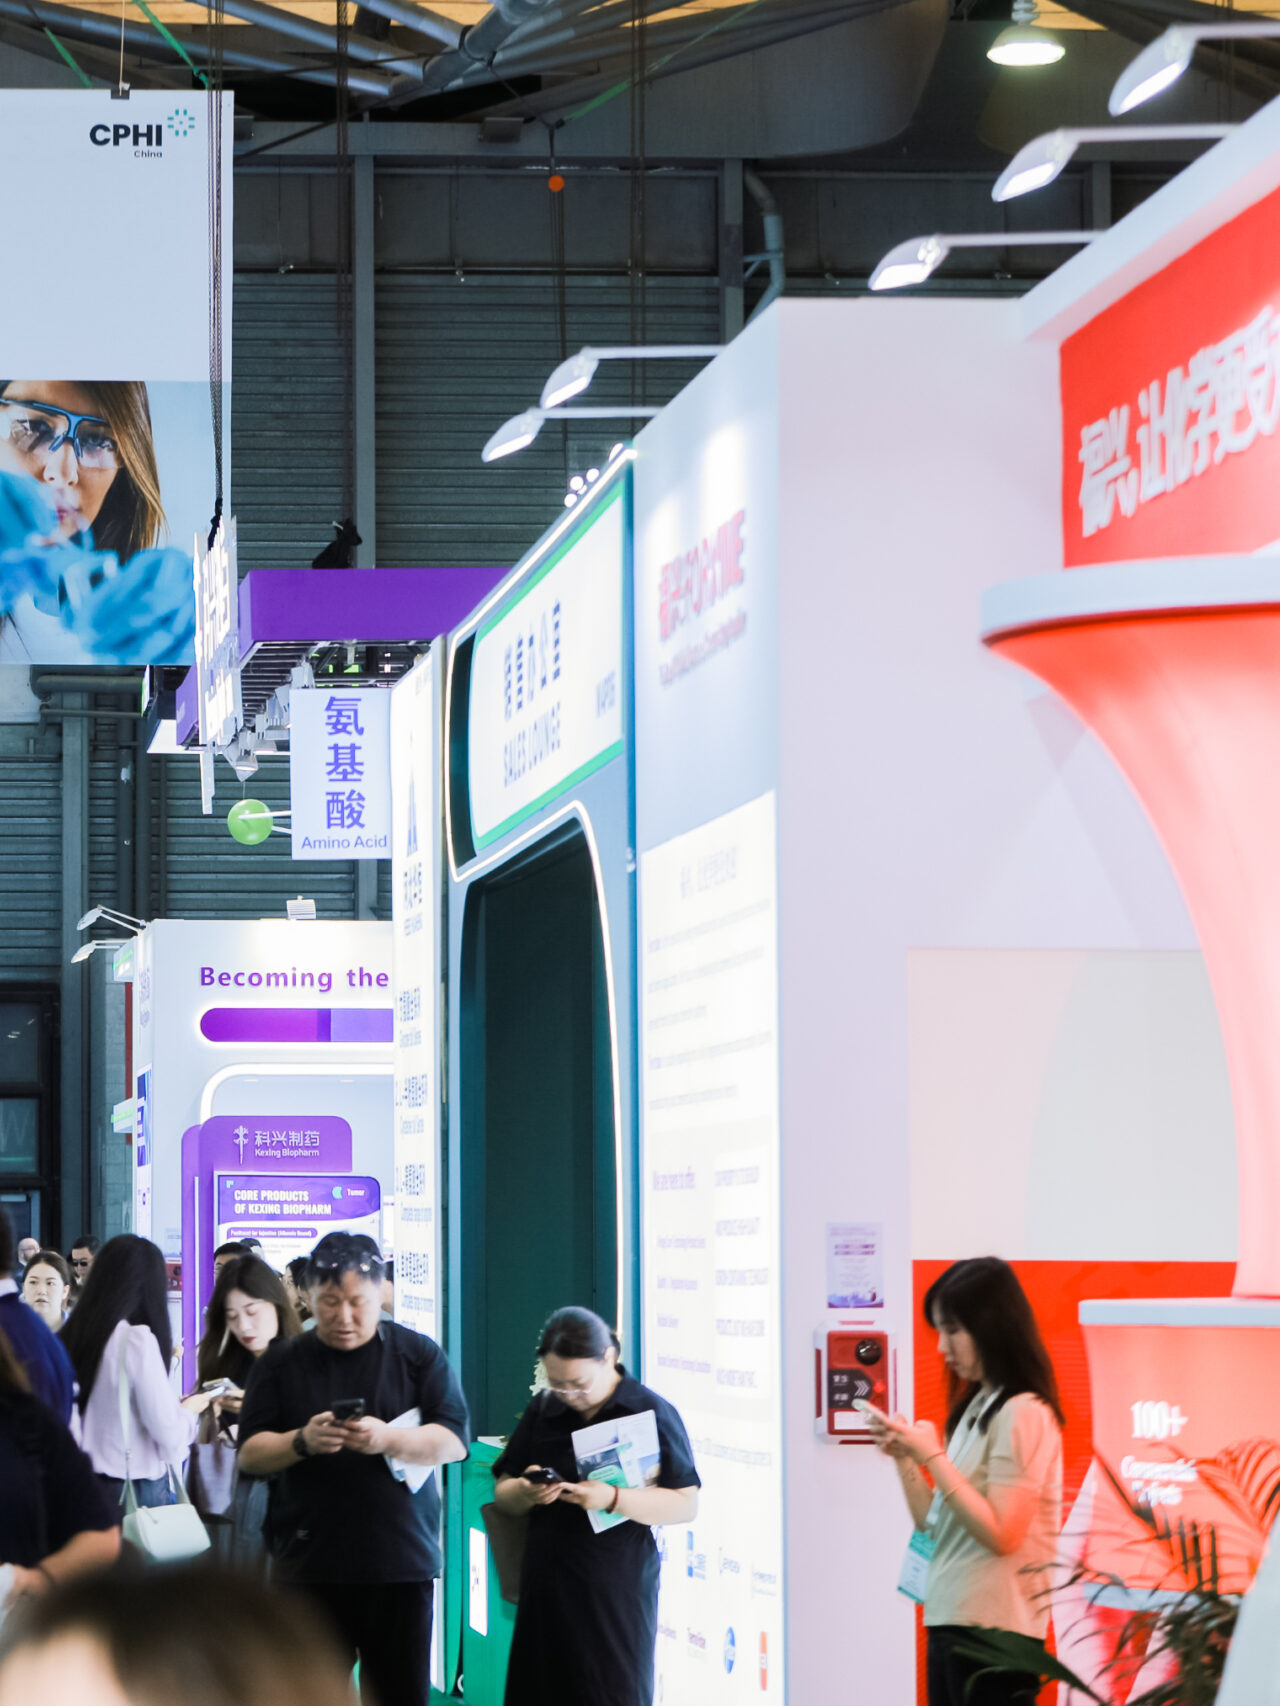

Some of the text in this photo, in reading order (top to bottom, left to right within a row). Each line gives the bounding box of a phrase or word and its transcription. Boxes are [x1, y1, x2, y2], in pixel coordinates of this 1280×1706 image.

[89, 124, 163, 146] CPHI
[134, 150, 163, 158] China
[325, 696, 366, 830] 氨基酸
[301, 835, 388, 849] Amino Acid
[199, 966, 389, 993] Becoming the
[254, 1130, 320, 1147] 科兴制药
[254, 1148, 320, 1158] Kexing Biopharm
[234, 1190, 309, 1202] CORE PRODUCTS
[234, 1204, 332, 1216] OF KEXING BIOPHARM
[1130, 1400, 1189, 1440] 100+
